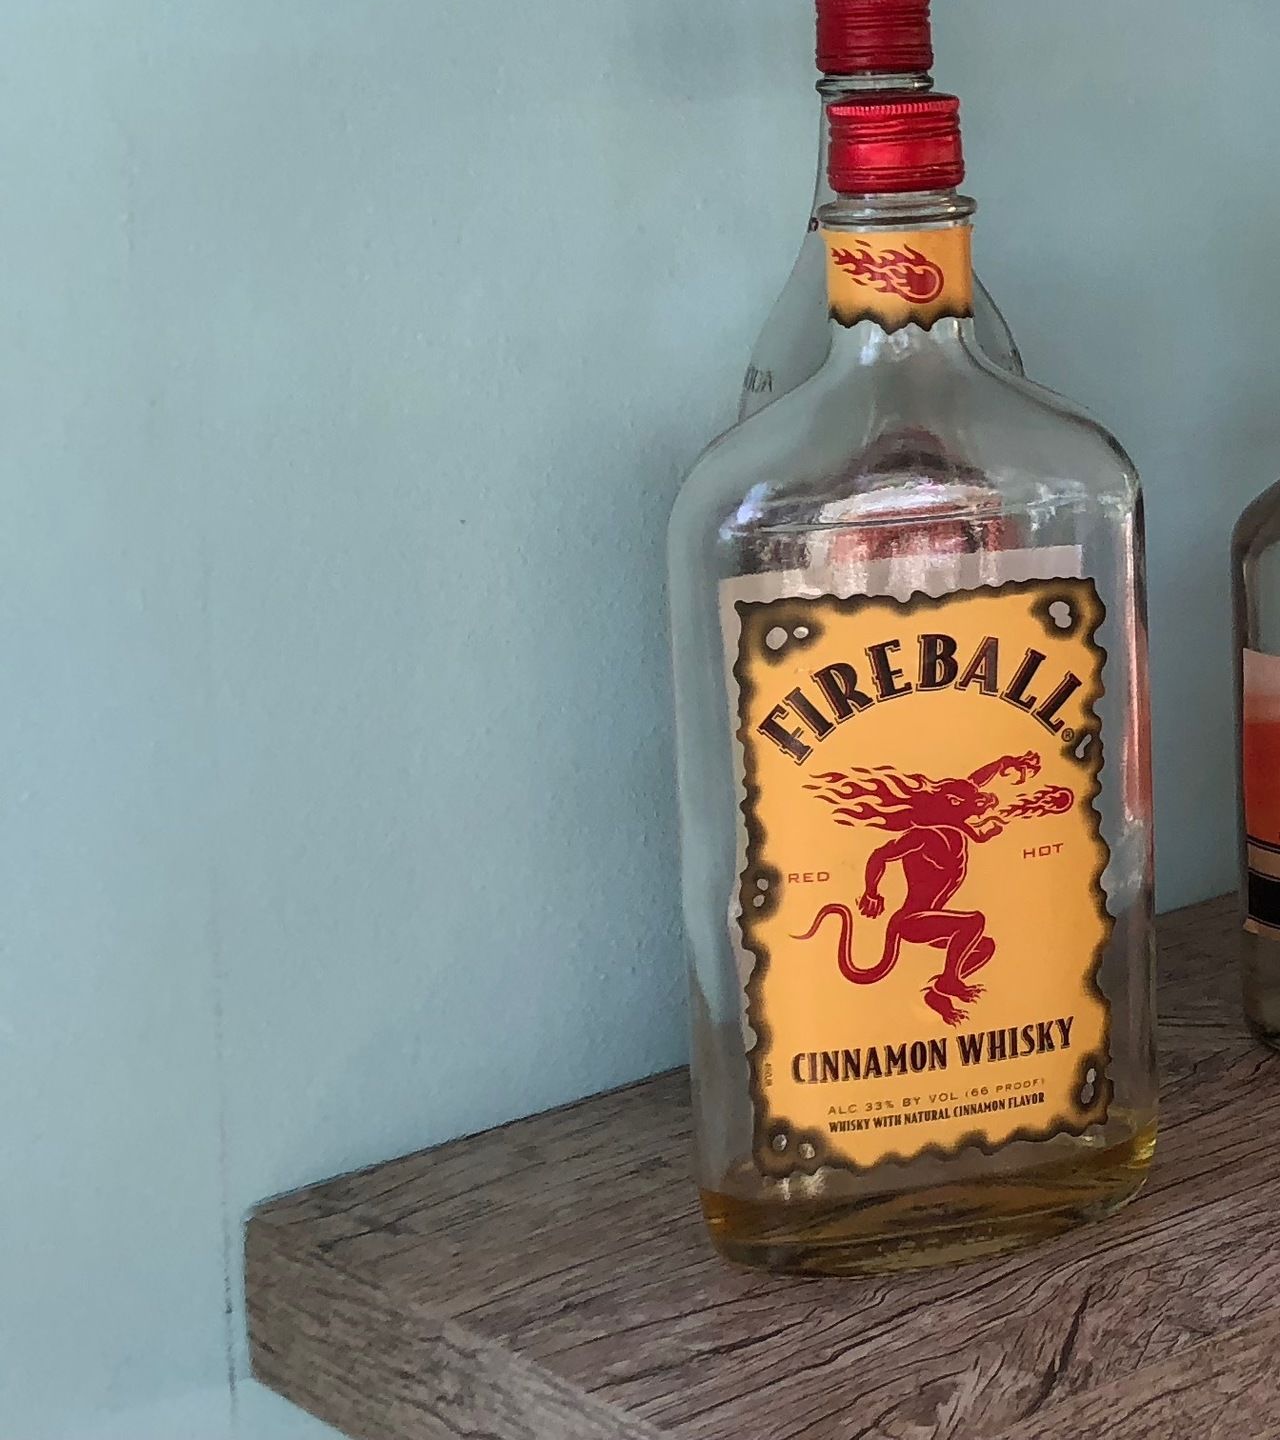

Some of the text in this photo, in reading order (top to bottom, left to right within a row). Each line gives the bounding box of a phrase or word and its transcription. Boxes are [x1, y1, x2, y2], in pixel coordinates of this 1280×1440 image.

[756, 633, 1085, 766] FIREBALL
[1022, 842, 1065, 860] HOT
[787, 870, 832, 885] RED
[791, 1015, 1076, 1086] CINNAMON WHISKY
[827, 1103, 858, 1116] ALC
[864, 1099, 895, 1112] 33%
[902, 1096, 922, 1108] BY
[928, 1091, 959, 1104] VOL
[828, 1091, 1045, 1133] WHISKY WITH NATURAL CINNAMON FLAVOR
